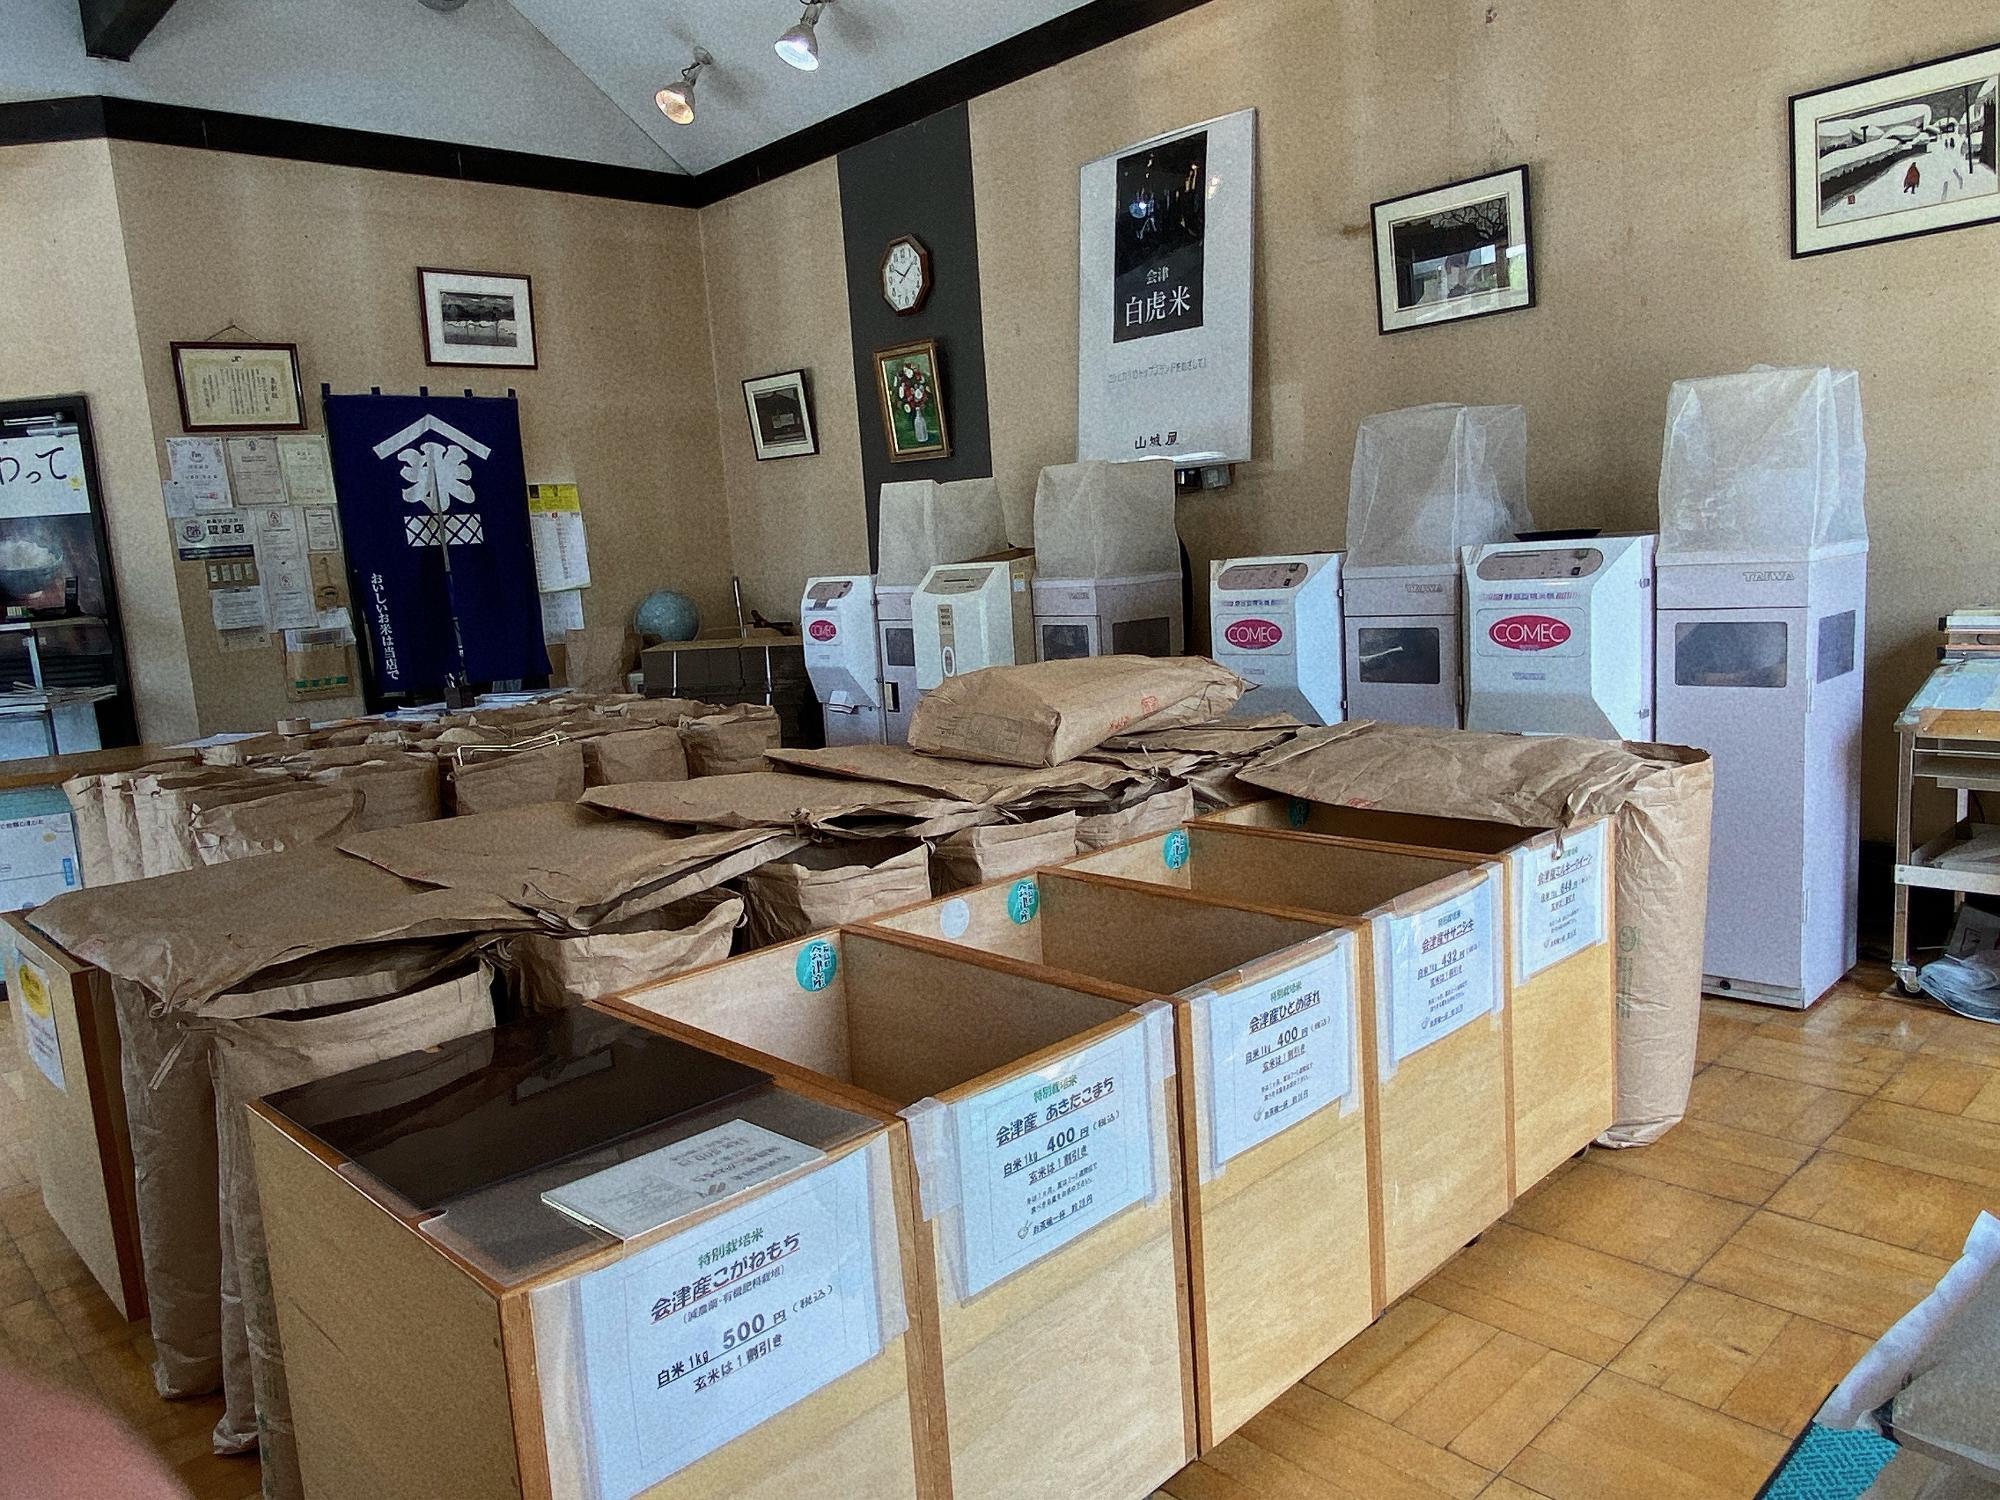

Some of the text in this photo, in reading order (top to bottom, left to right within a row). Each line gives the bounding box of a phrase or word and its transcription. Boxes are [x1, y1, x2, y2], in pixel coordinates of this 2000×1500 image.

[1146, 265, 1169, 285] 会津
[1126, 286, 1191, 327] 白虎米
[371, 573, 400, 680] おいしいお米は当店で
[1227, 625, 1278, 643] COMEC
[1493, 623, 1565, 643] COMEC
[1442, 949, 1457, 966] 432
[1249, 989, 1321, 1033] 会津産ひとめぼれ
[1277, 1026, 1298, 1047] 400
[996, 1076, 1115, 1147] 会津産 あきたこまち
[1046, 1126, 1075, 1151] 400
[698, 1227, 765, 1269] 特別栽培米
[652, 1232, 801, 1321] 会津産こがねもち
[722, 1313, 765, 1350] 500
[772, 1309, 787, 1325] 円
[694, 1333, 784, 1390] 玄米は1割引き
